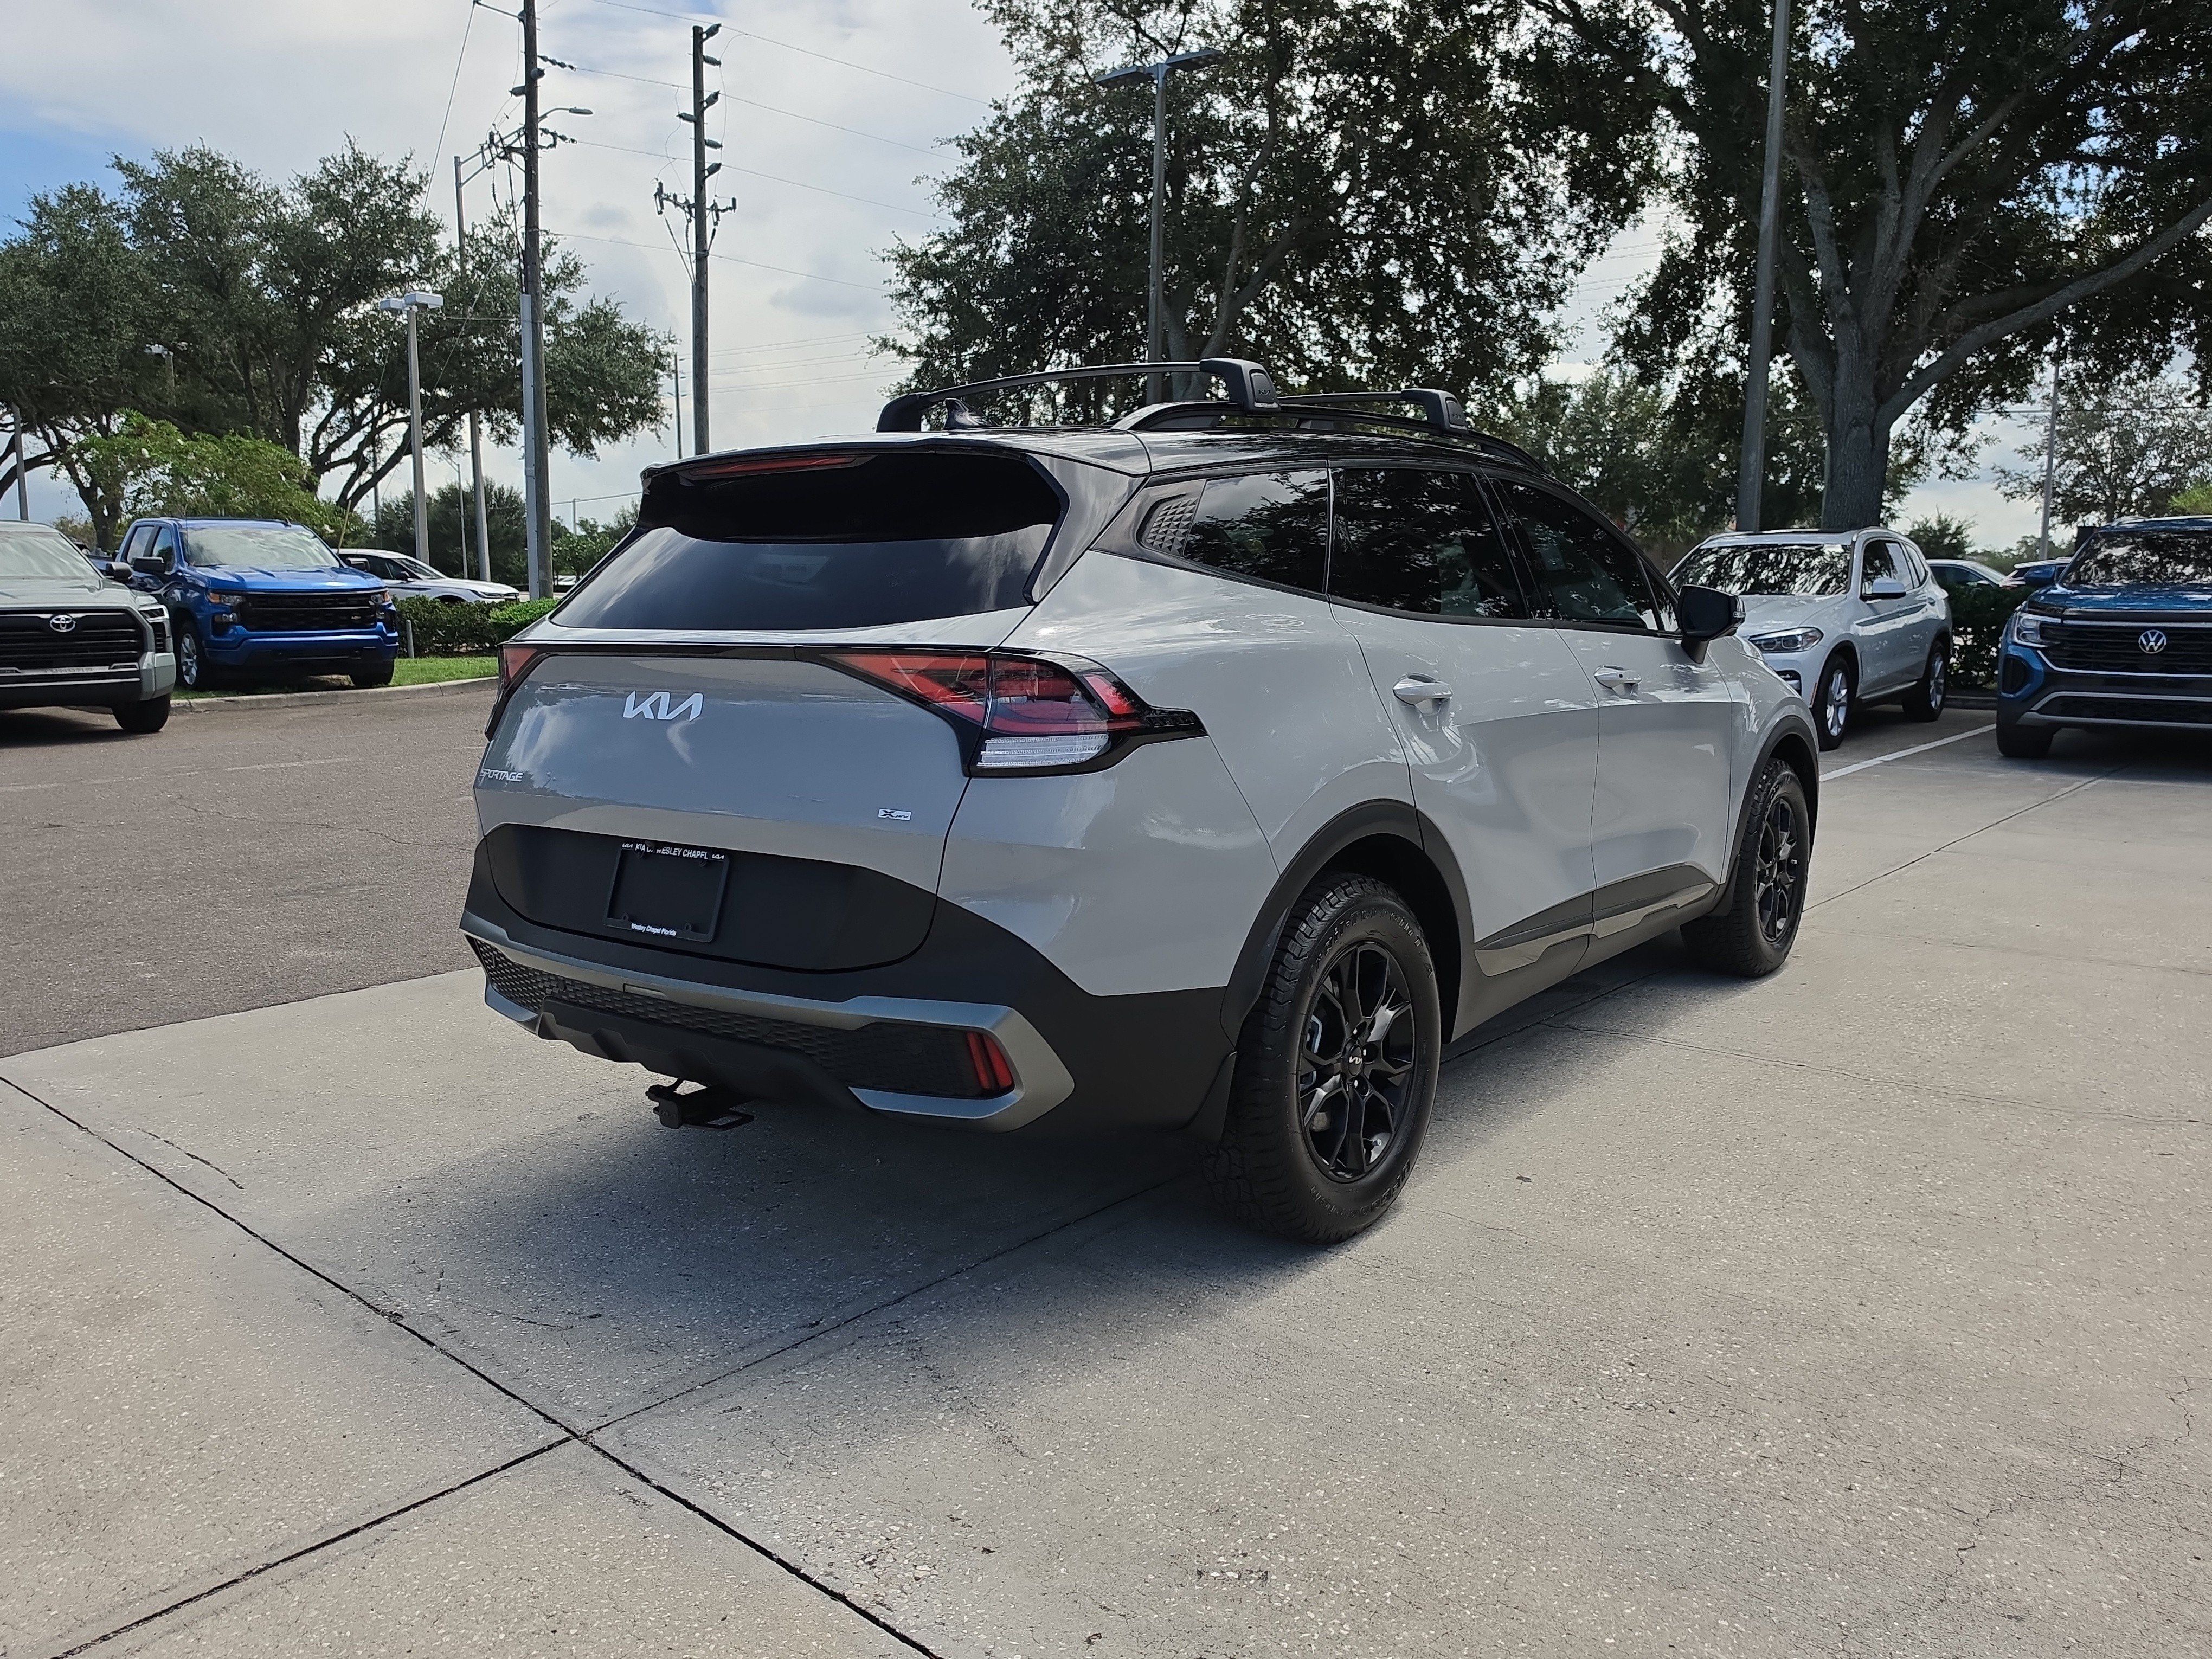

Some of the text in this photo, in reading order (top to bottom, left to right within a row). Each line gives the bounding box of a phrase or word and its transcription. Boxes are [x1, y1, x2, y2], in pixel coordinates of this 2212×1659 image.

[623, 690, 704, 722] KIA
[479, 768, 524, 782] SPORTAGE
[635, 843, 645, 851] KIA
[631, 923, 677, 936] Wesley Chapel Florida
